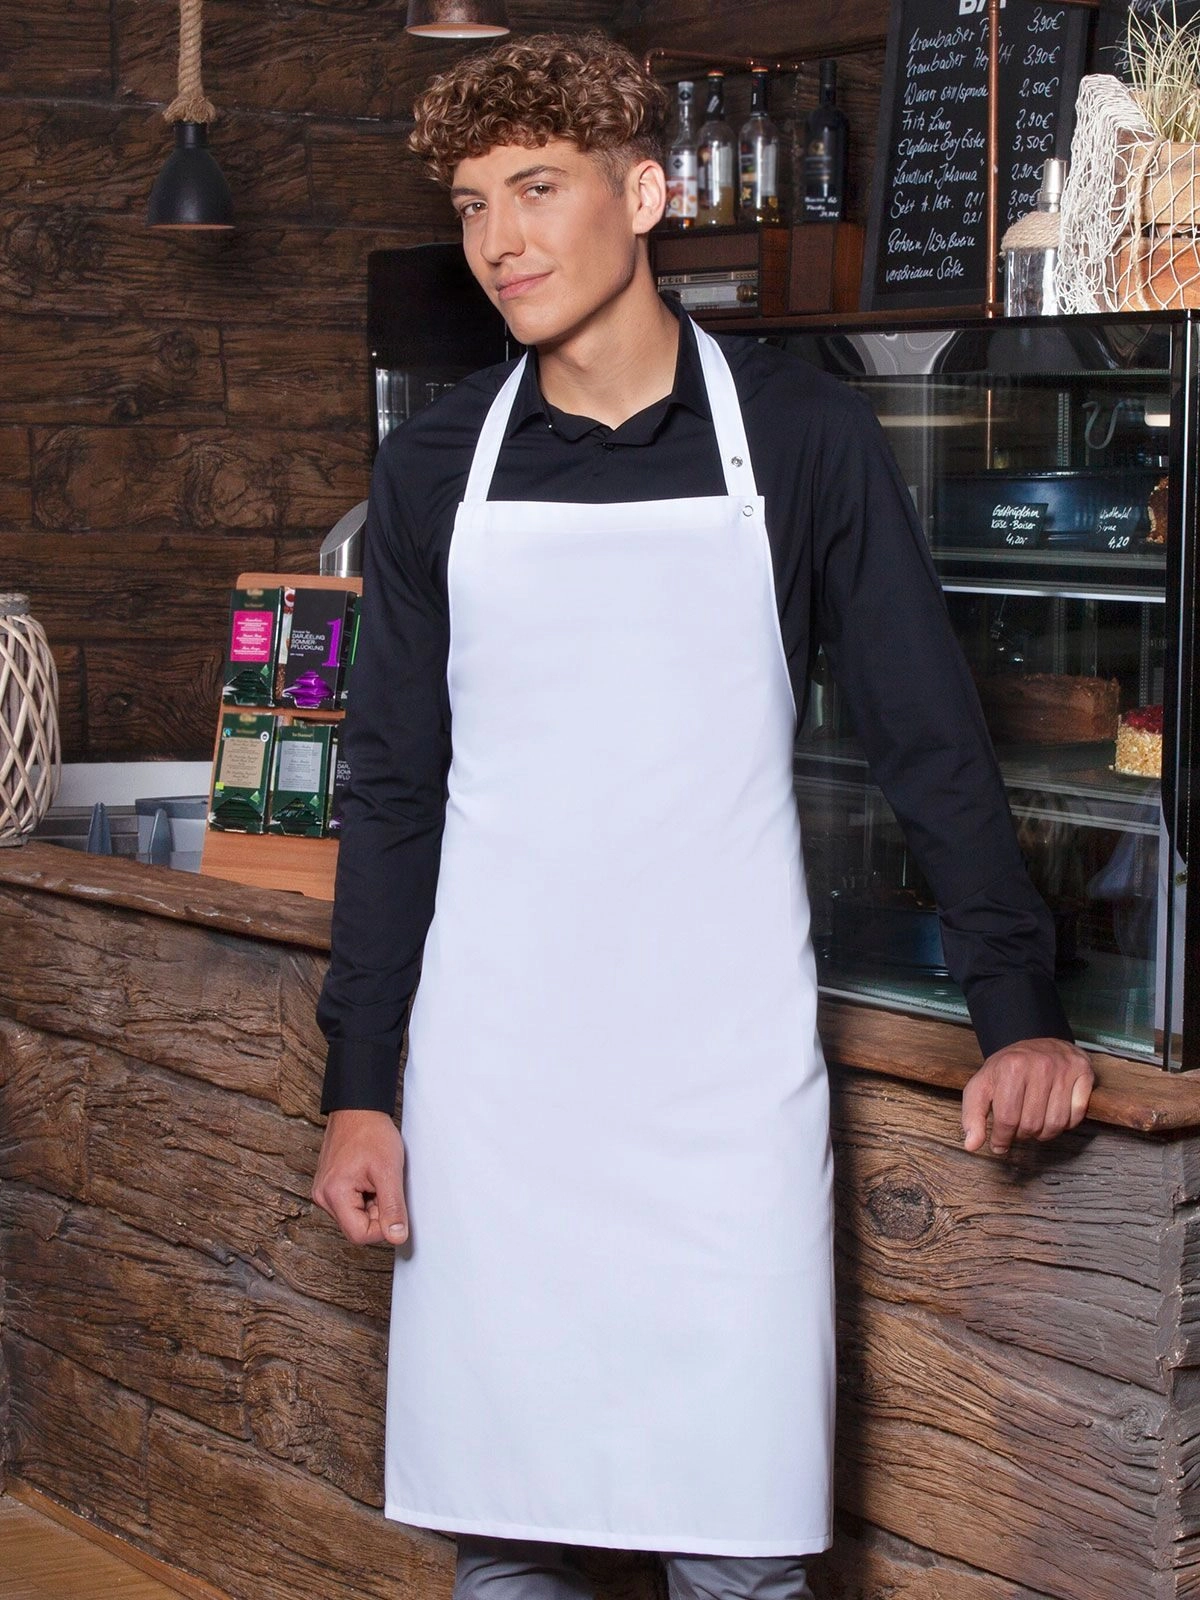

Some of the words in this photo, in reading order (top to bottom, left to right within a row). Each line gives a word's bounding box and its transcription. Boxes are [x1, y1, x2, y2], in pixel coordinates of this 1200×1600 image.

[1027, 7, 1064, 34] 3,90€
[1023, 44, 1060, 66] 3,90€
[1018, 77, 1059, 99] 2,50€
[1015, 109, 1054, 130] 2,90€
[1012, 134, 1054, 152] 3,50€
[1107, 536, 1130, 550] 4,20
